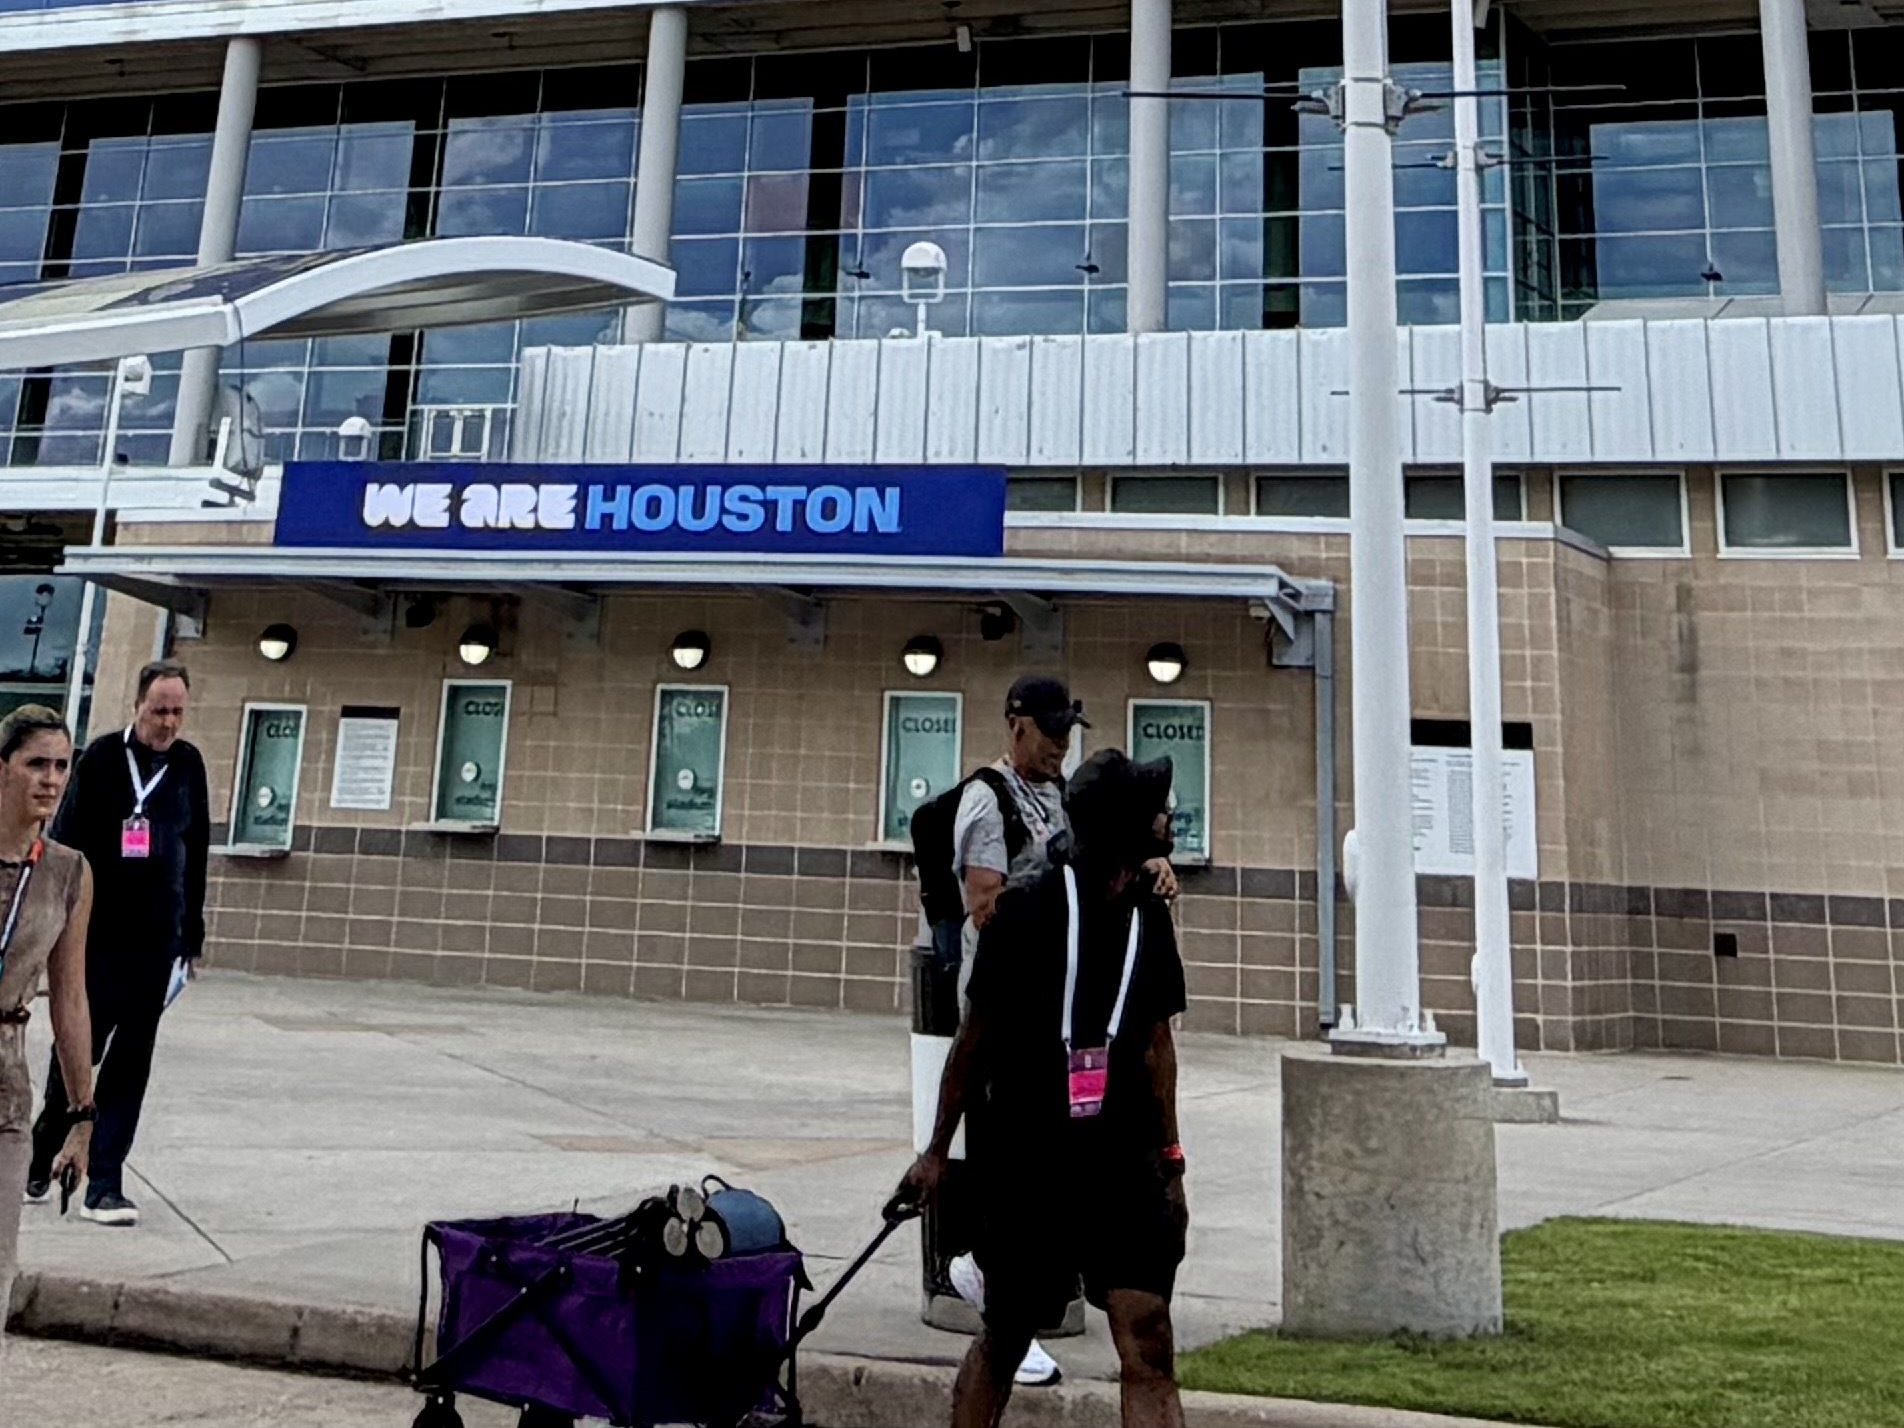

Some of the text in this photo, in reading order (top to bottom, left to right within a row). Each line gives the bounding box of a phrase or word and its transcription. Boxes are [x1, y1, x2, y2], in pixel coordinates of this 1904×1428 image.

[363, 482, 902, 534] WE ARE HOUSTON
